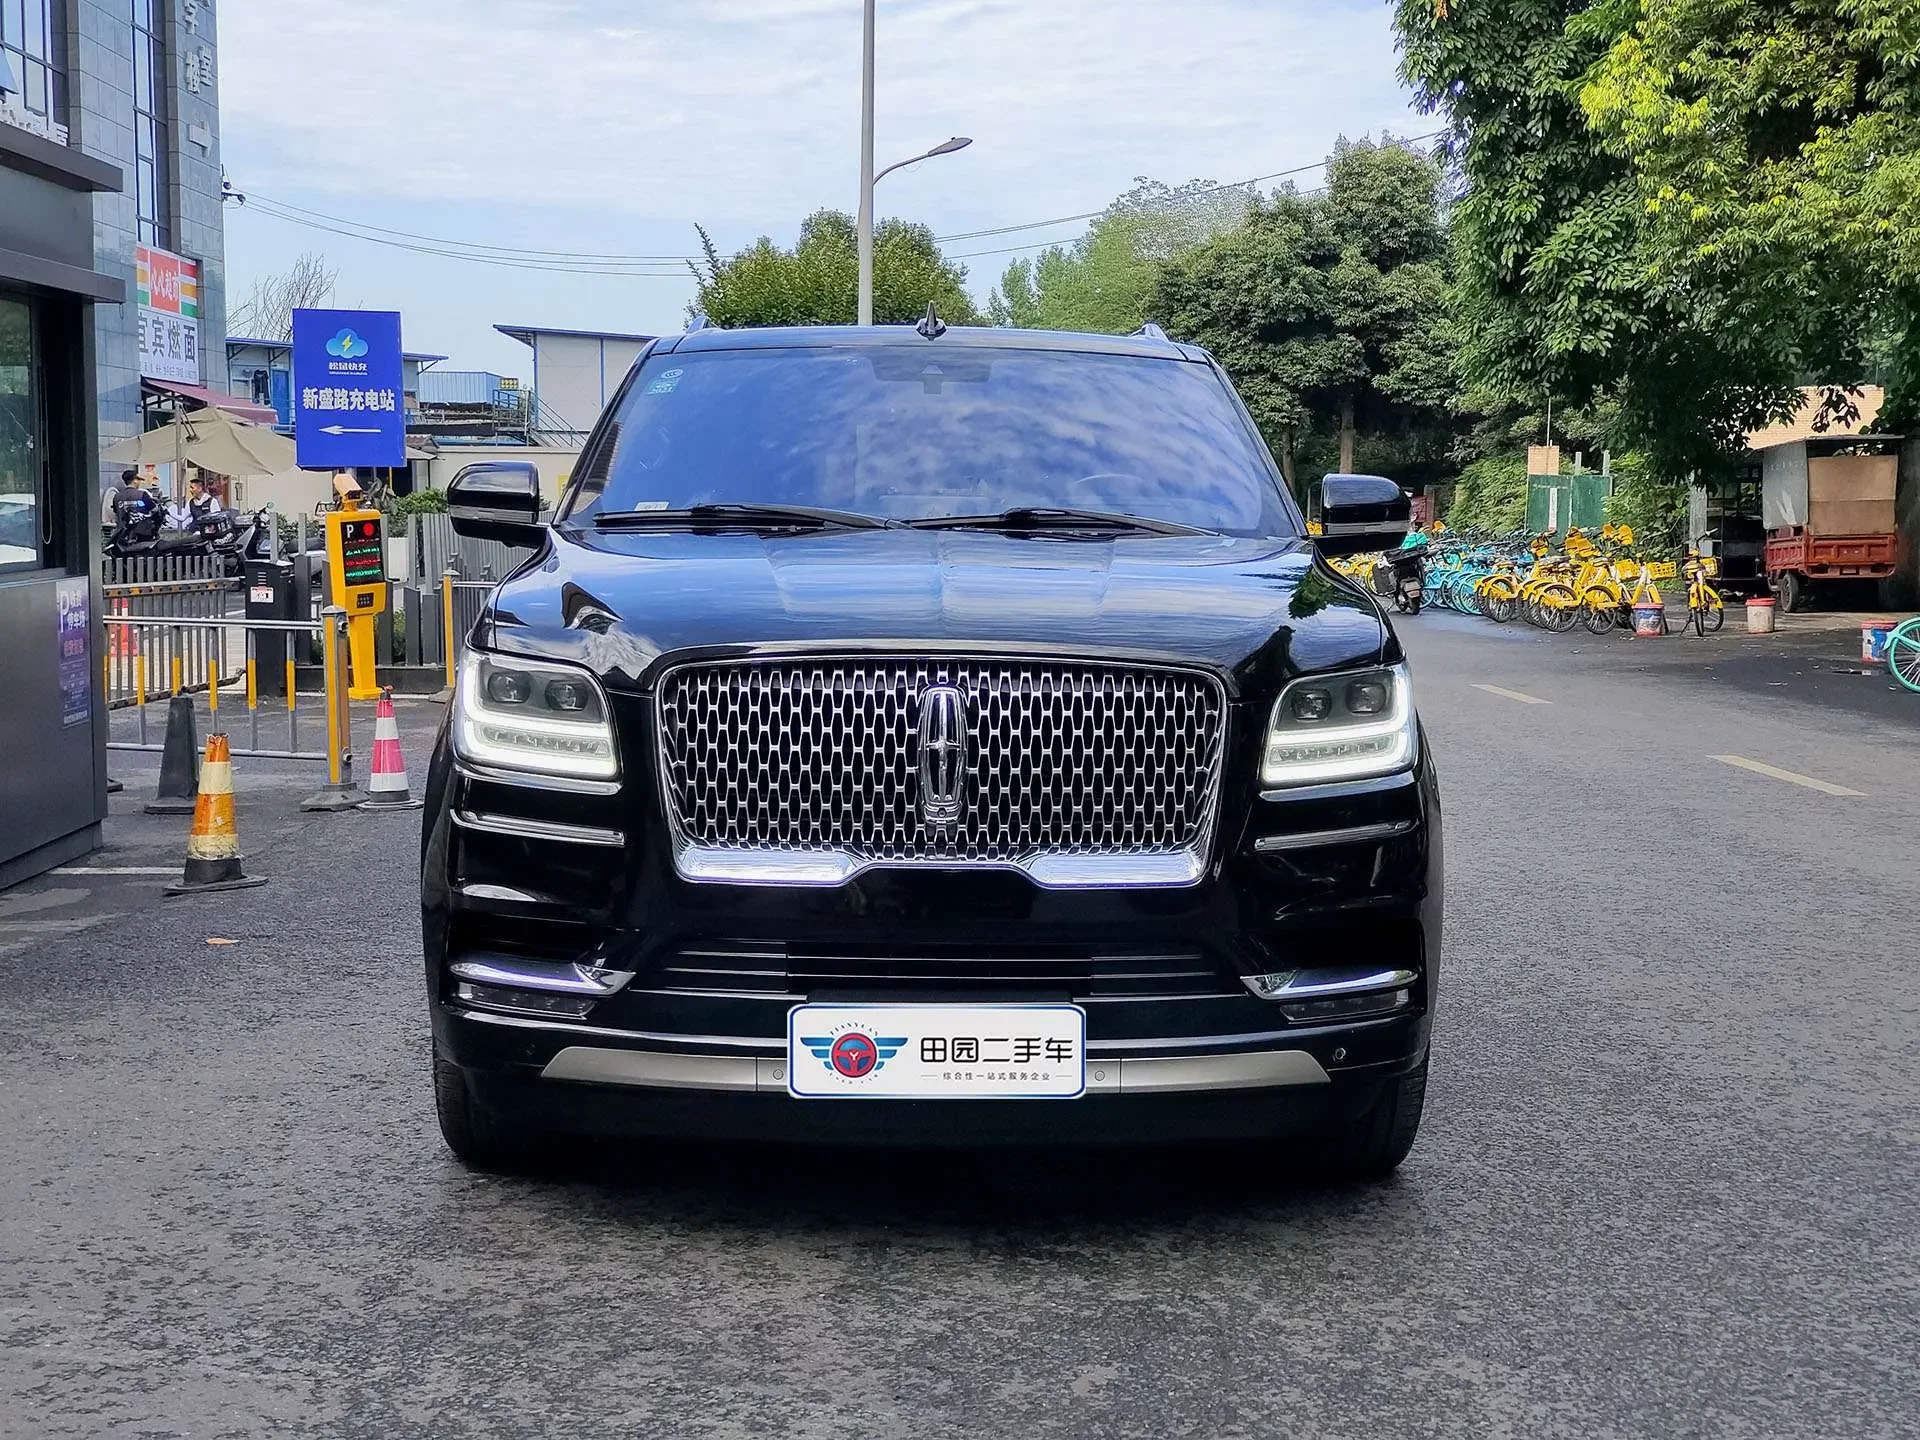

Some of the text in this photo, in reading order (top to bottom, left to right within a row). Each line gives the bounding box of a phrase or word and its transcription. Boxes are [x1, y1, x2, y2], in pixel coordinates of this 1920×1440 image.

[303, 387, 395, 412] 新盛路充电站
[346, 524, 354, 538] P
[920, 1037, 1073, 1063] 田园二手车
[943, 1071, 1050, 1081] 综合性一站式服务企业
